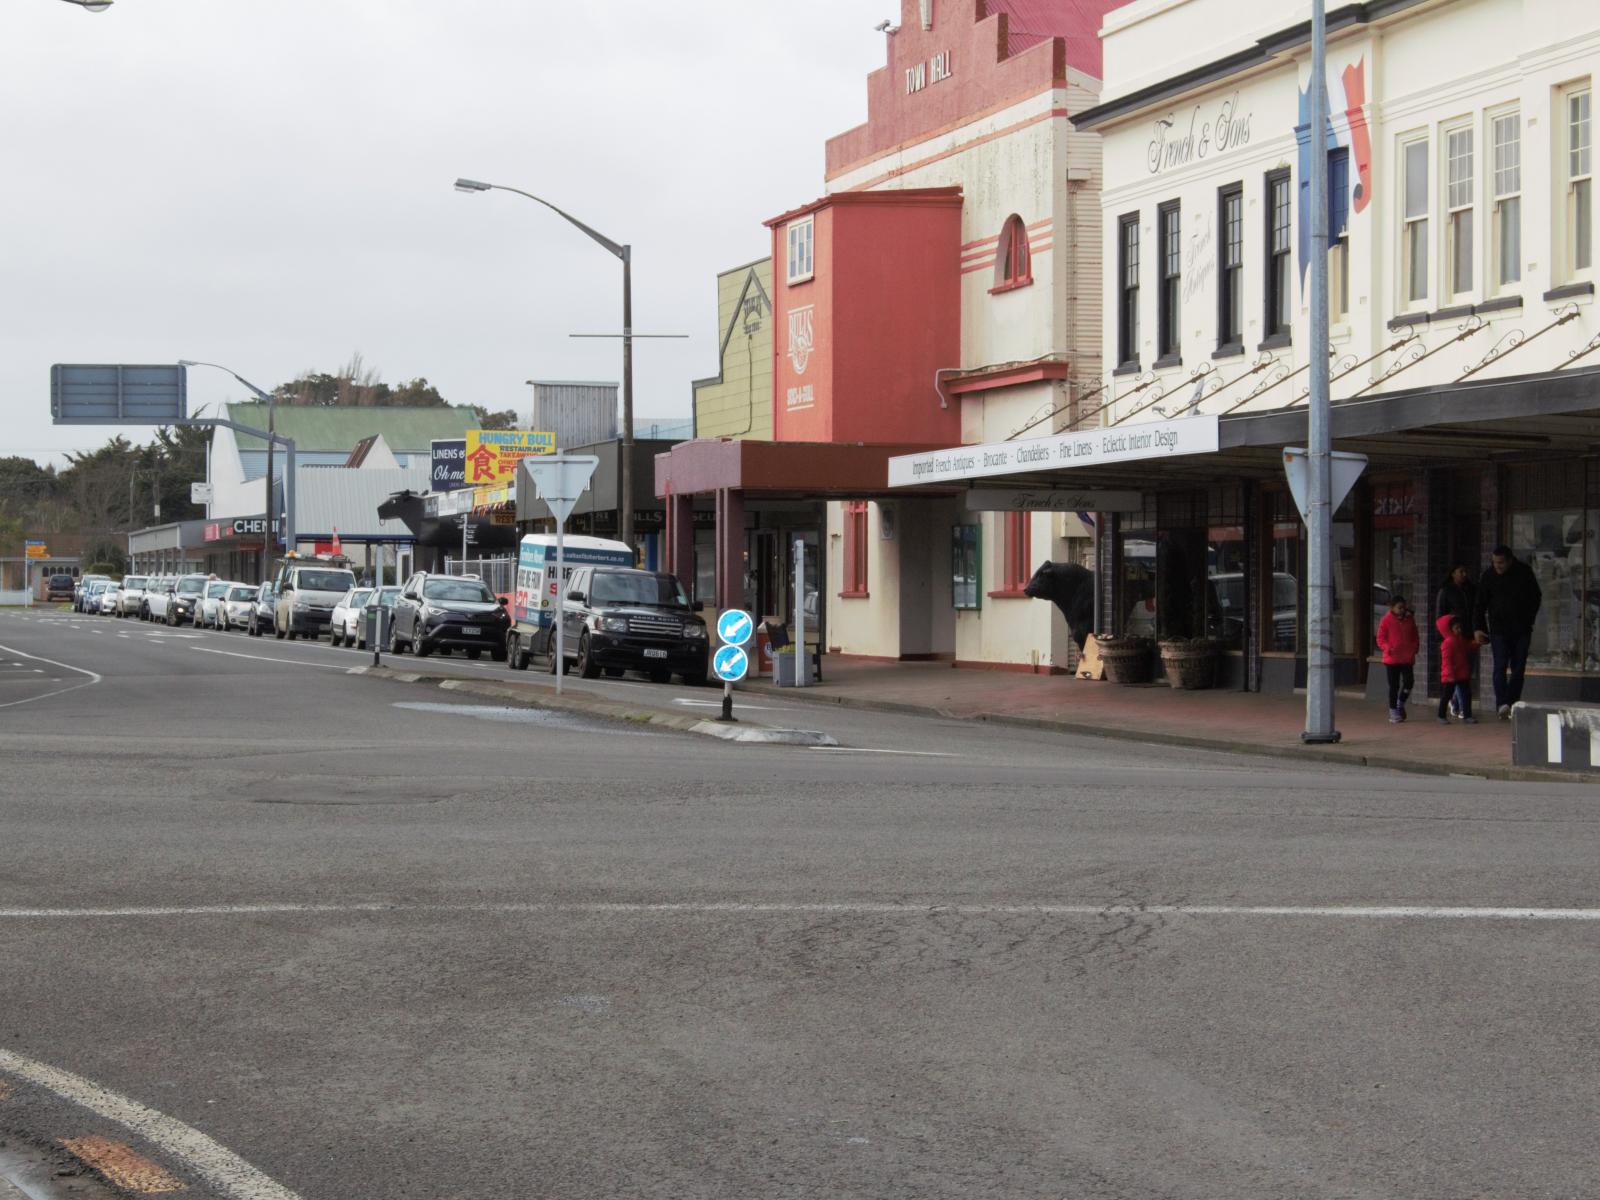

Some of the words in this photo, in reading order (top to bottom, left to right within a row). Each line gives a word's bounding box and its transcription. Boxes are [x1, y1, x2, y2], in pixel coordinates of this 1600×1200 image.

[906, 63, 927, 95] TOWN
[931, 49, 952, 84] HALL
[1147, 104, 1201, 175] French
[1198, 122, 1210, 159] &
[1215, 90, 1253, 152] Sons
[432, 448, 457, 460] LINENS
[479, 431, 524, 444] HUNGRY
[527, 433, 553, 446] BULL
[912, 457, 934, 479] Imported
[935, 456, 952, 473] French
[953, 454, 975, 475] Antiques
[983, 450, 1008, 467] Brocante
[1016, 443, 1050, 463] Chandeliers
[1060, 442, 1071, 459] Fine
[1073, 439, 1093, 456] Linens
[1102, 435, 1127, 454] Eclectic
[1128, 431, 1152, 450] Interior
[1154, 427, 1178, 452] Design
[433, 465, 450, 481] Oh
[466, 443, 498, 481] 食
